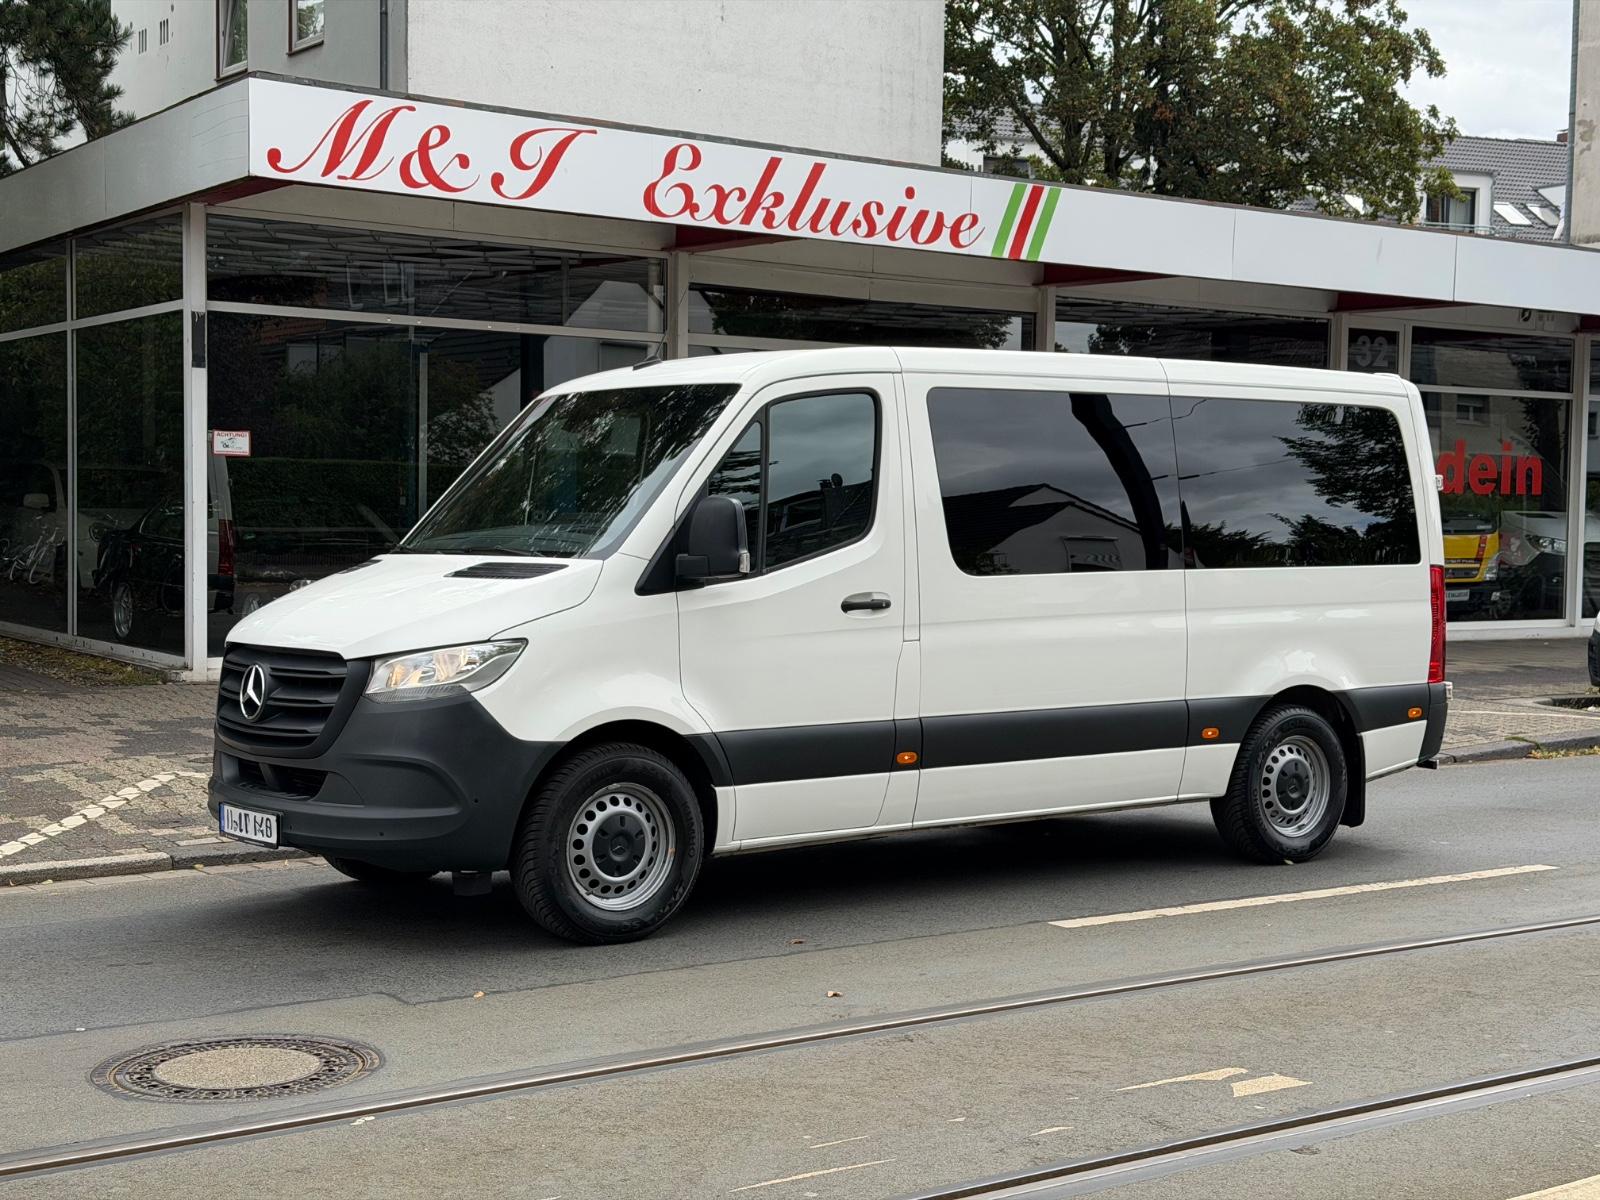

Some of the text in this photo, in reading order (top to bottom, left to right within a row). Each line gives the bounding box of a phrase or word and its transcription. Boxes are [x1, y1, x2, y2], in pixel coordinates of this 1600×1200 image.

[642, 143, 986, 249] Exklusive
[1355, 335, 1389, 368] 32
[1436, 437, 1543, 496] dein
